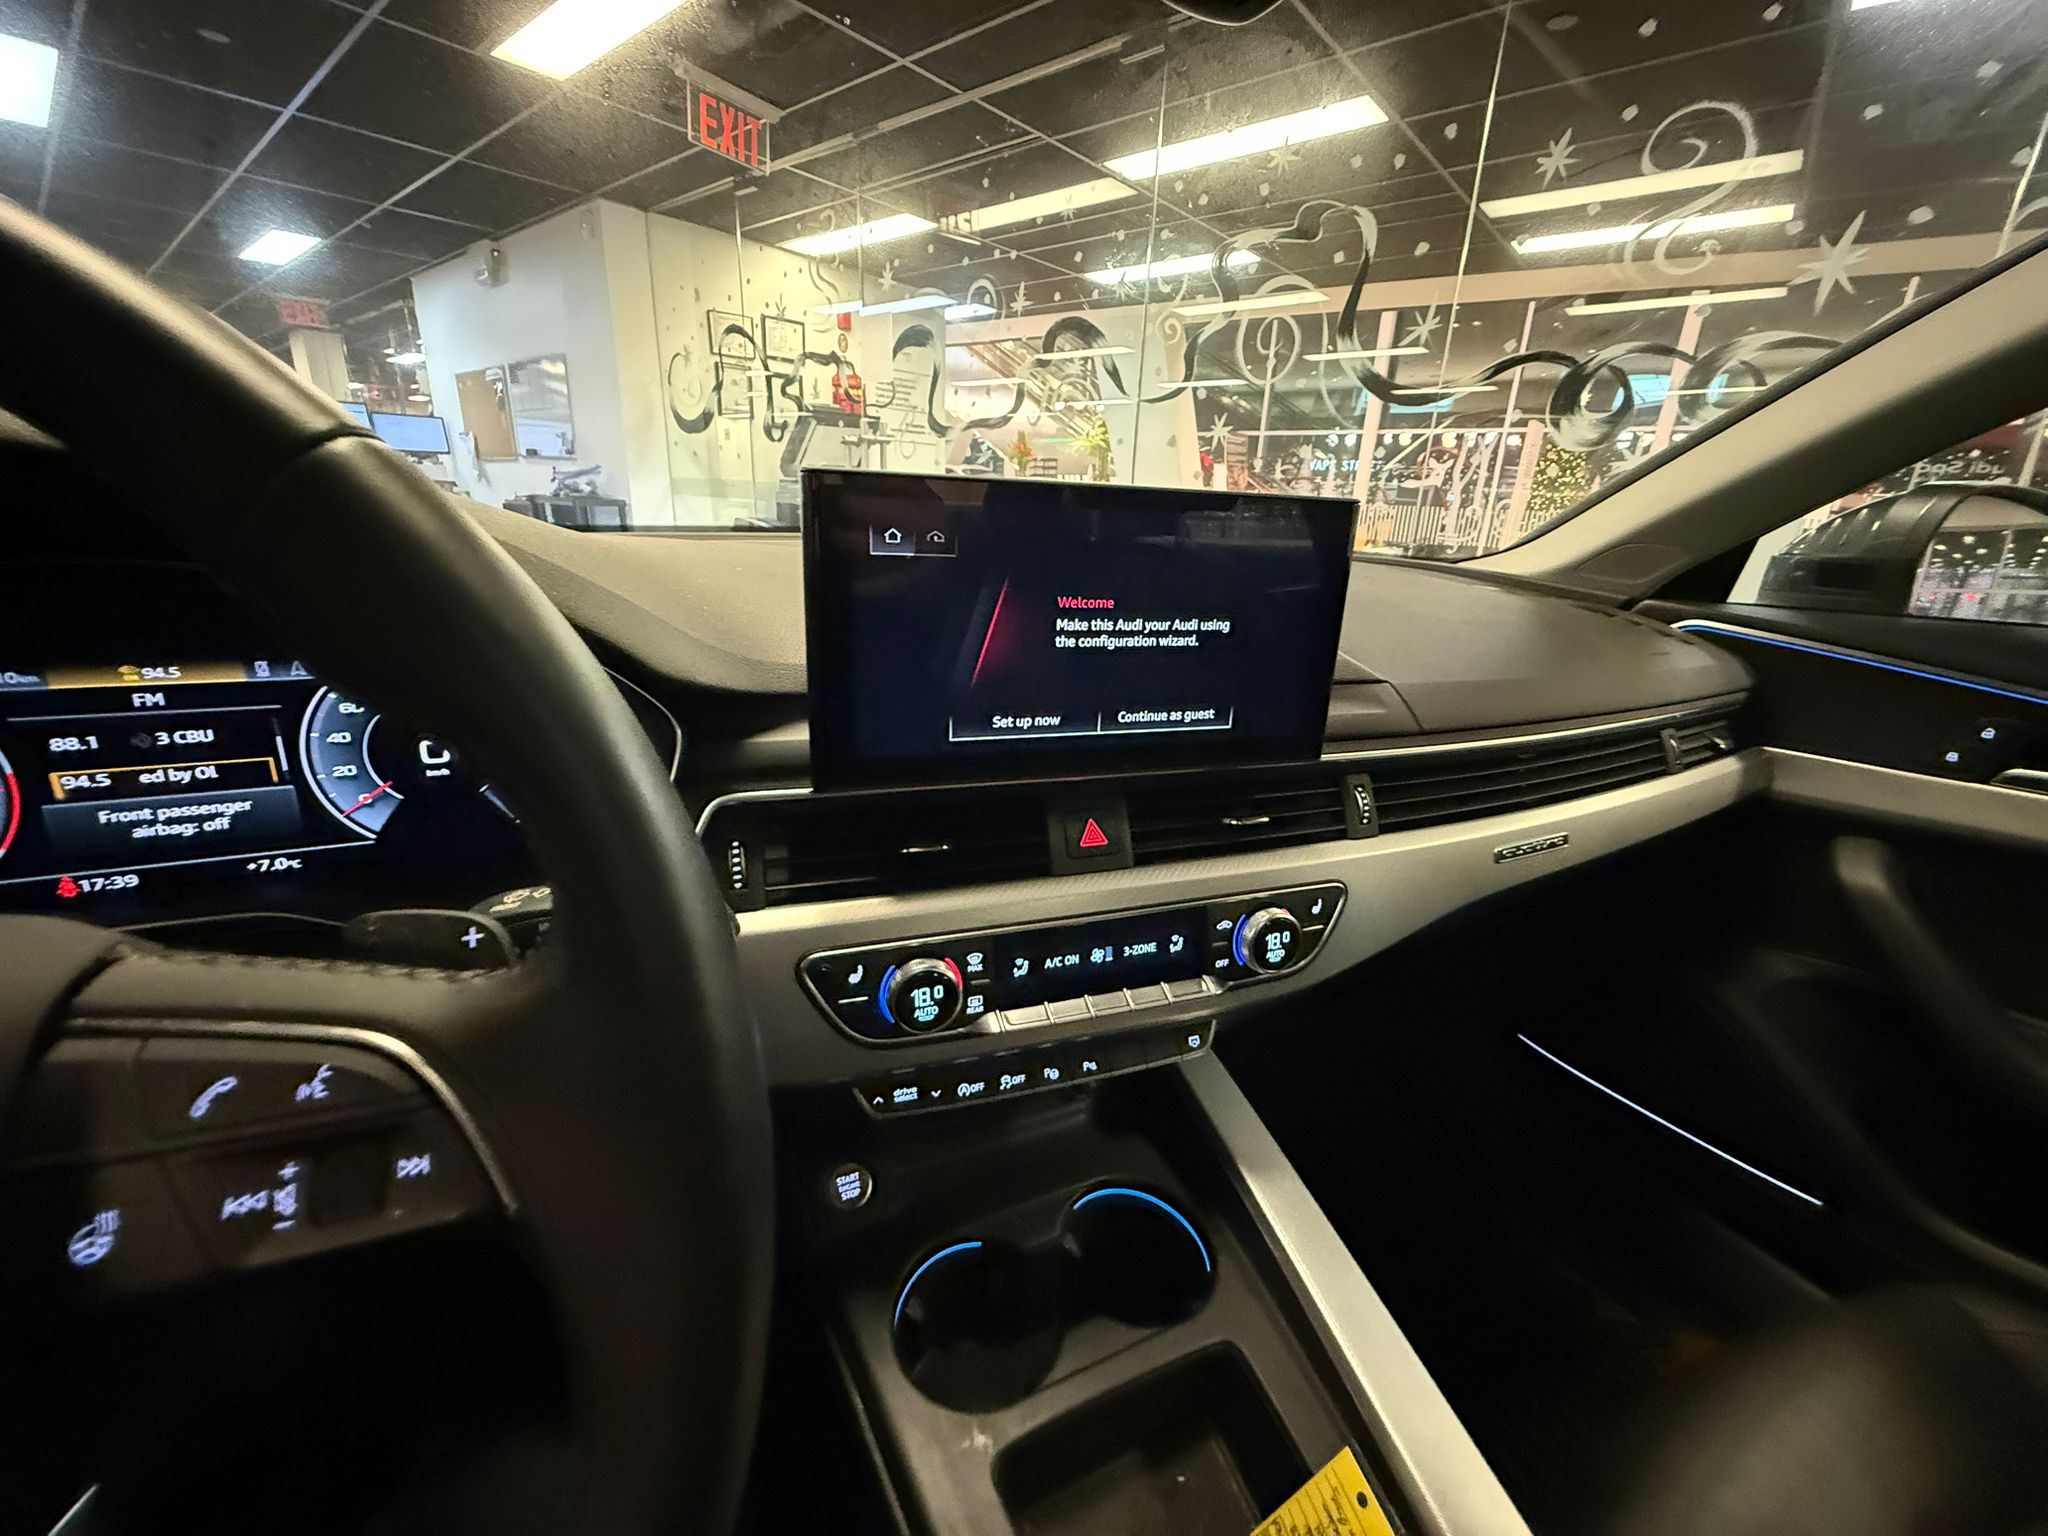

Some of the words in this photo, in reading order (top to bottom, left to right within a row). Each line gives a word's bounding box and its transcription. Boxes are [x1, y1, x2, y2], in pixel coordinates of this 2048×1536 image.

[699, 92, 762, 168] EXIT
[1309, 459, 1336, 471] VAP
[1057, 596, 1115, 609] Welcome
[1056, 618, 1089, 631] Make
[1091, 618, 1114, 631] this
[1115, 618, 1143, 631] Audi
[1144, 620, 1171, 634] your
[1172, 618, 1199, 631] Audi
[1200, 618, 1231, 634] using
[1055, 635, 1076, 648] the
[1078, 634, 1157, 650] configuration
[1159, 634, 1199, 647] wizard.
[140, 666, 183, 680] 94.5
[131, 692, 166, 708] FM
[992, 715, 1014, 728] Set
[1015, 716, 1033, 730] up
[1034, 716, 1061, 727] now
[1117, 710, 1168, 723] Continue
[1169, 711, 1183, 722] as
[1184, 708, 1215, 723] guest
[49, 735, 99, 752] 88.1
[155, 731, 171, 746] 3
[173, 729, 215, 745] CBU
[326, 731, 352, 744] 40
[59, 772, 112, 791] 94.5
[138, 766, 166, 784] ed
[168, 767, 194, 785] by
[332, 765, 358, 777] 20
[97, 808, 154, 825] Front
[156, 799, 253, 822] passenger
[131, 820, 200, 840] airbag:
[203, 816, 232, 833] off
[78, 874, 140, 893] 17:39
[1123, 942, 1158, 957] 3-ZONE
[1266, 948, 1286, 960] AUTO
[1044, 955, 1063, 970] A/C
[1064, 954, 1080, 967] ON
[1215, 958, 1230, 968] OFF
[914, 1005, 939, 1019] AUTO
[1012, 1074, 1026, 1085] OFF
[970, 1082, 985, 1093] OFF
[835, 1171, 860, 1187] START
[840, 1187, 861, 1202] STOP
